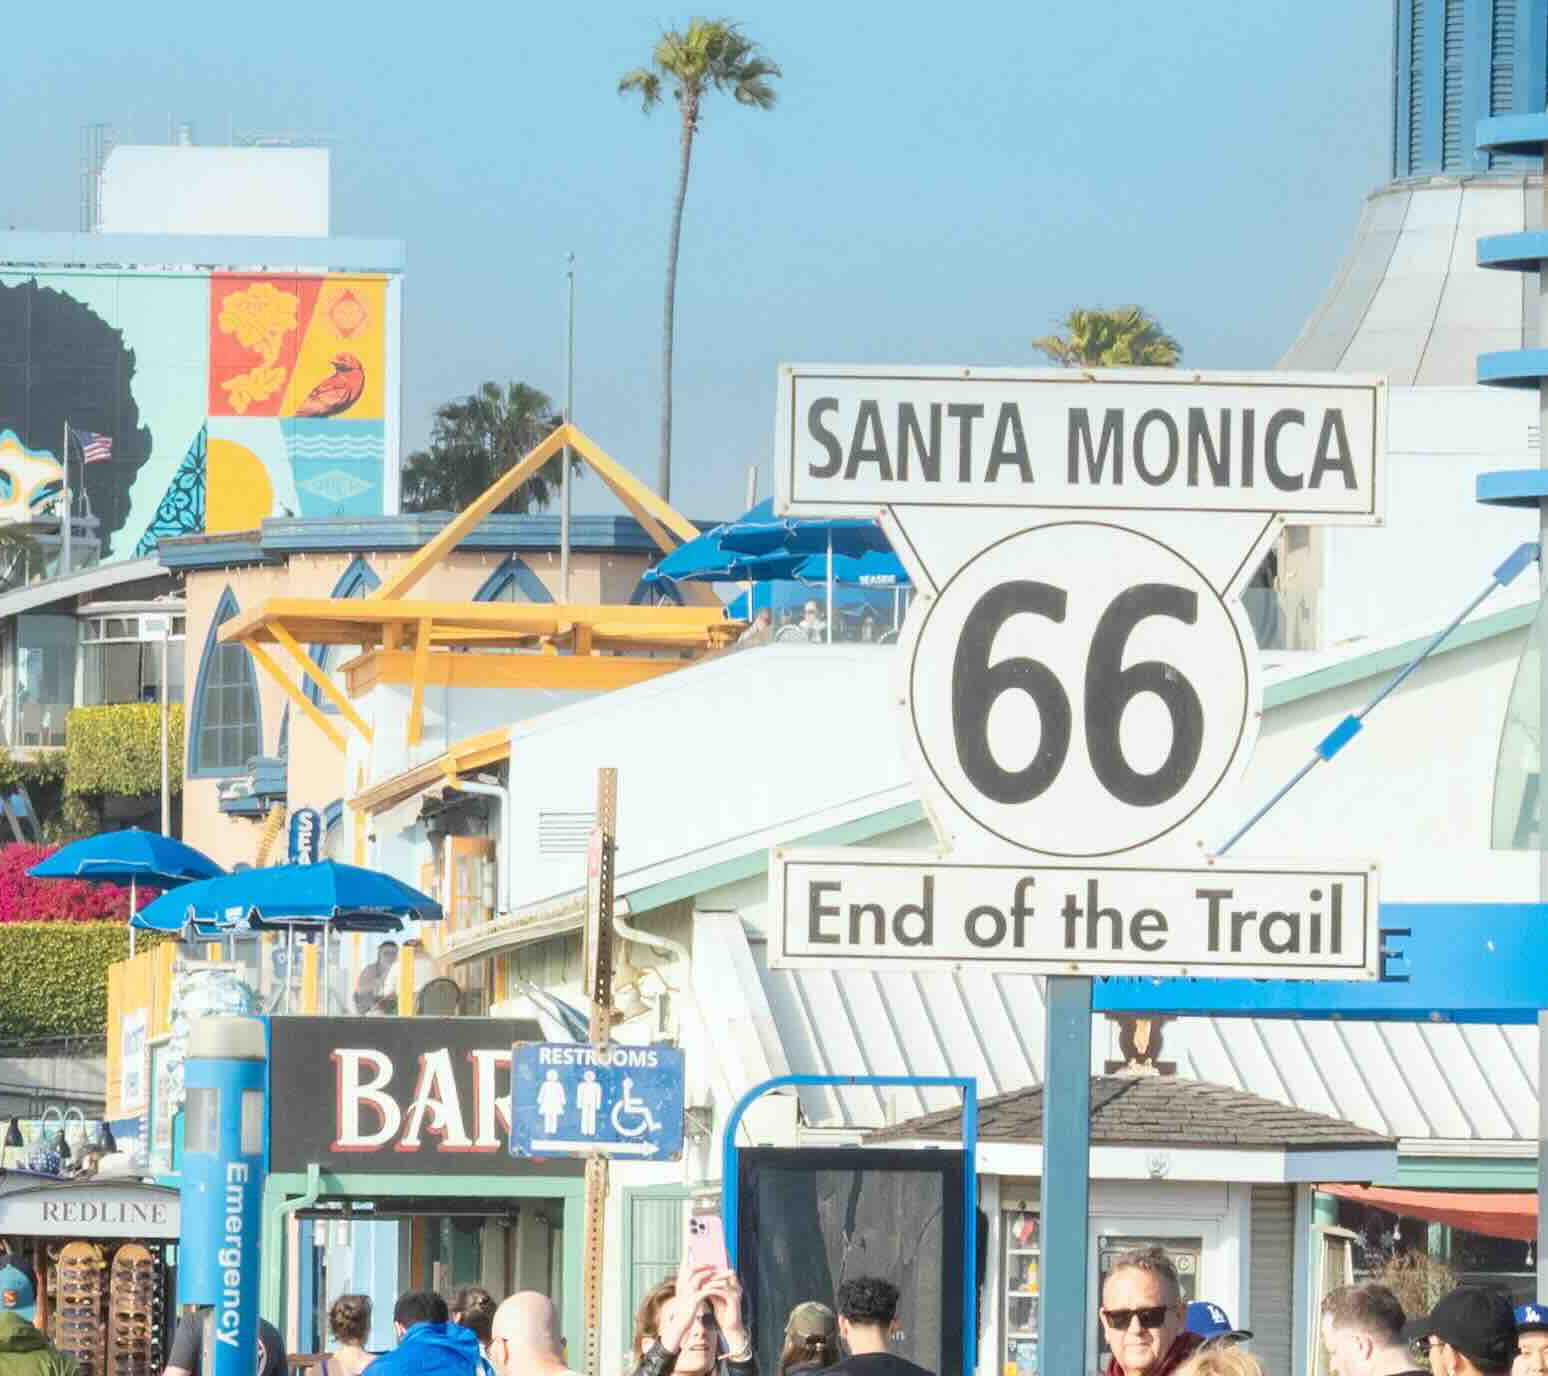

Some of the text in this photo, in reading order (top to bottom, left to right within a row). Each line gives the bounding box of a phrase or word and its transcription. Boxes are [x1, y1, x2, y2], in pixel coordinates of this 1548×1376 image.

[807, 397, 1358, 492] SANTA MONICA
[952, 579, 1205, 807] 66
[807, 876, 935, 947] End
[965, 877, 1035, 951] of
[1061, 879, 1168, 952] the
[1196, 881, 1344, 956] Trail
[539, 1047, 658, 1067] RESTROOMS
[42, 1200, 167, 1225] REDLINE
[216, 1162, 248, 1347] Emergency
